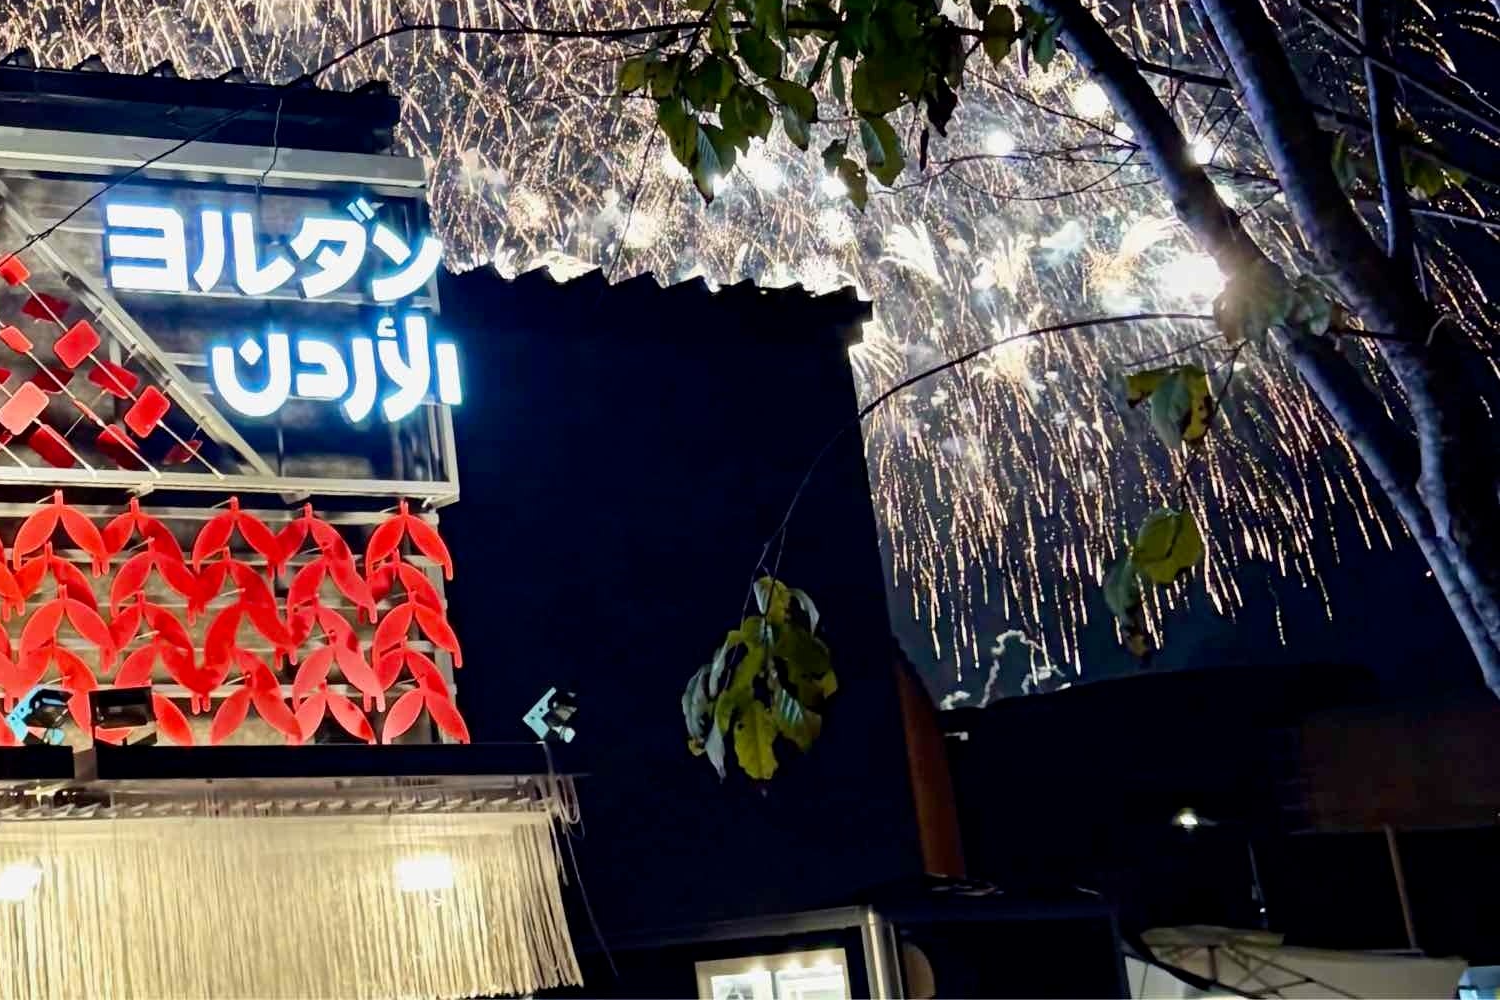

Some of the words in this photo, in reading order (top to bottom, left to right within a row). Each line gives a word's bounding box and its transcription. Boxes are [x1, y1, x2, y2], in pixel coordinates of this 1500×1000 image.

[106, 198, 443, 301] ヨルダン
[211, 315, 462, 423] الأردن
